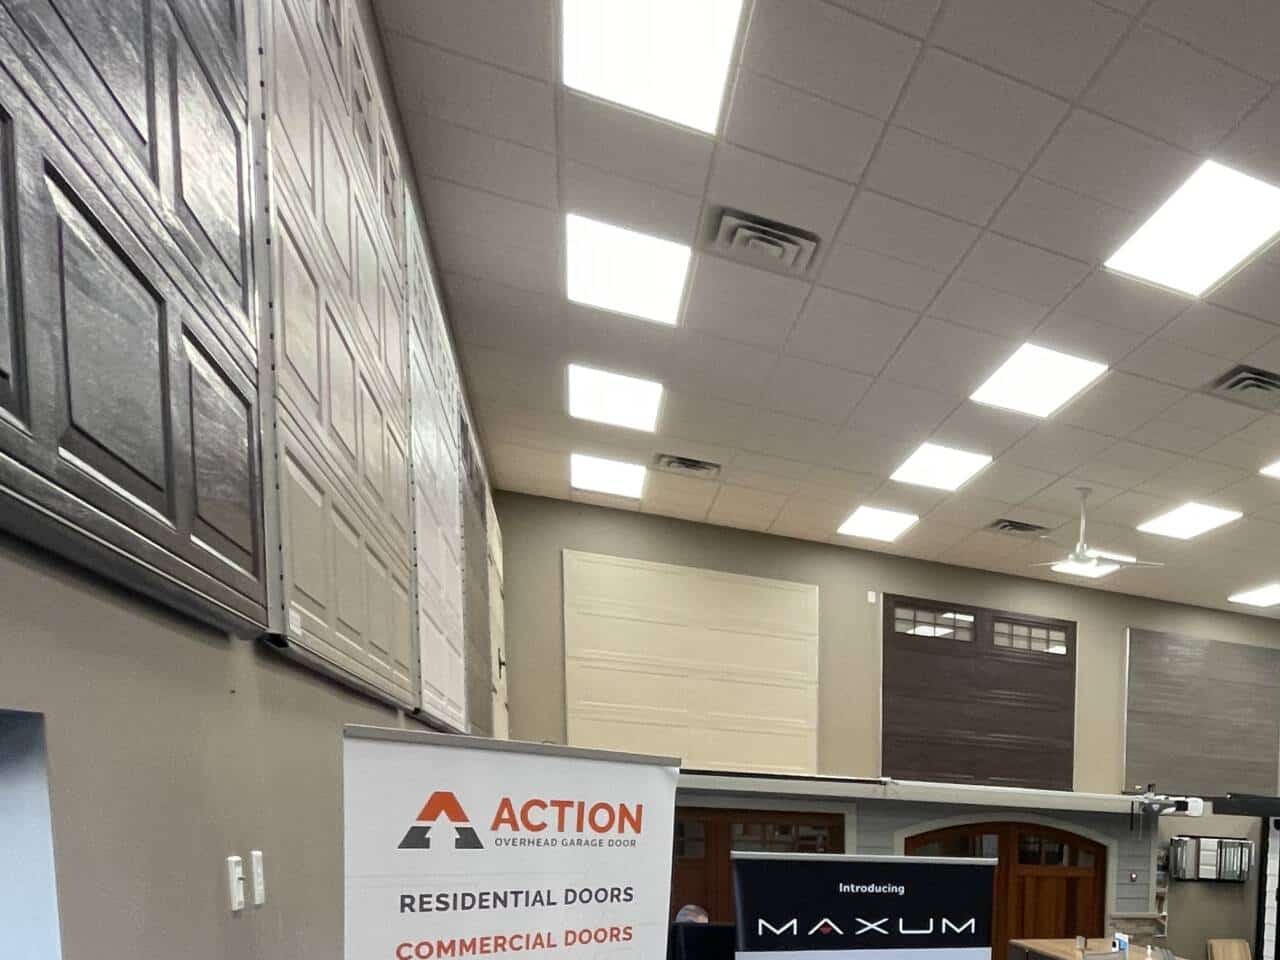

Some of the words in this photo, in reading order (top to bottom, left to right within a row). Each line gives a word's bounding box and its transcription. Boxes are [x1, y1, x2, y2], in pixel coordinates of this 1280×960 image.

[490, 797, 643, 834] ACTION
[495, 838, 557, 847] OVERHEAD
[561, 838, 603, 847] GARAGE
[608, 839, 636, 847] DOOR
[839, 883, 905, 895] Introducing
[400, 889, 556, 913] RESIDENTIAL
[564, 887, 634, 905] DOORS
[758, 918, 976, 935] MAXUM
[396, 932, 556, 960] COMMERCIAL
[564, 926, 633, 947] DOORS
